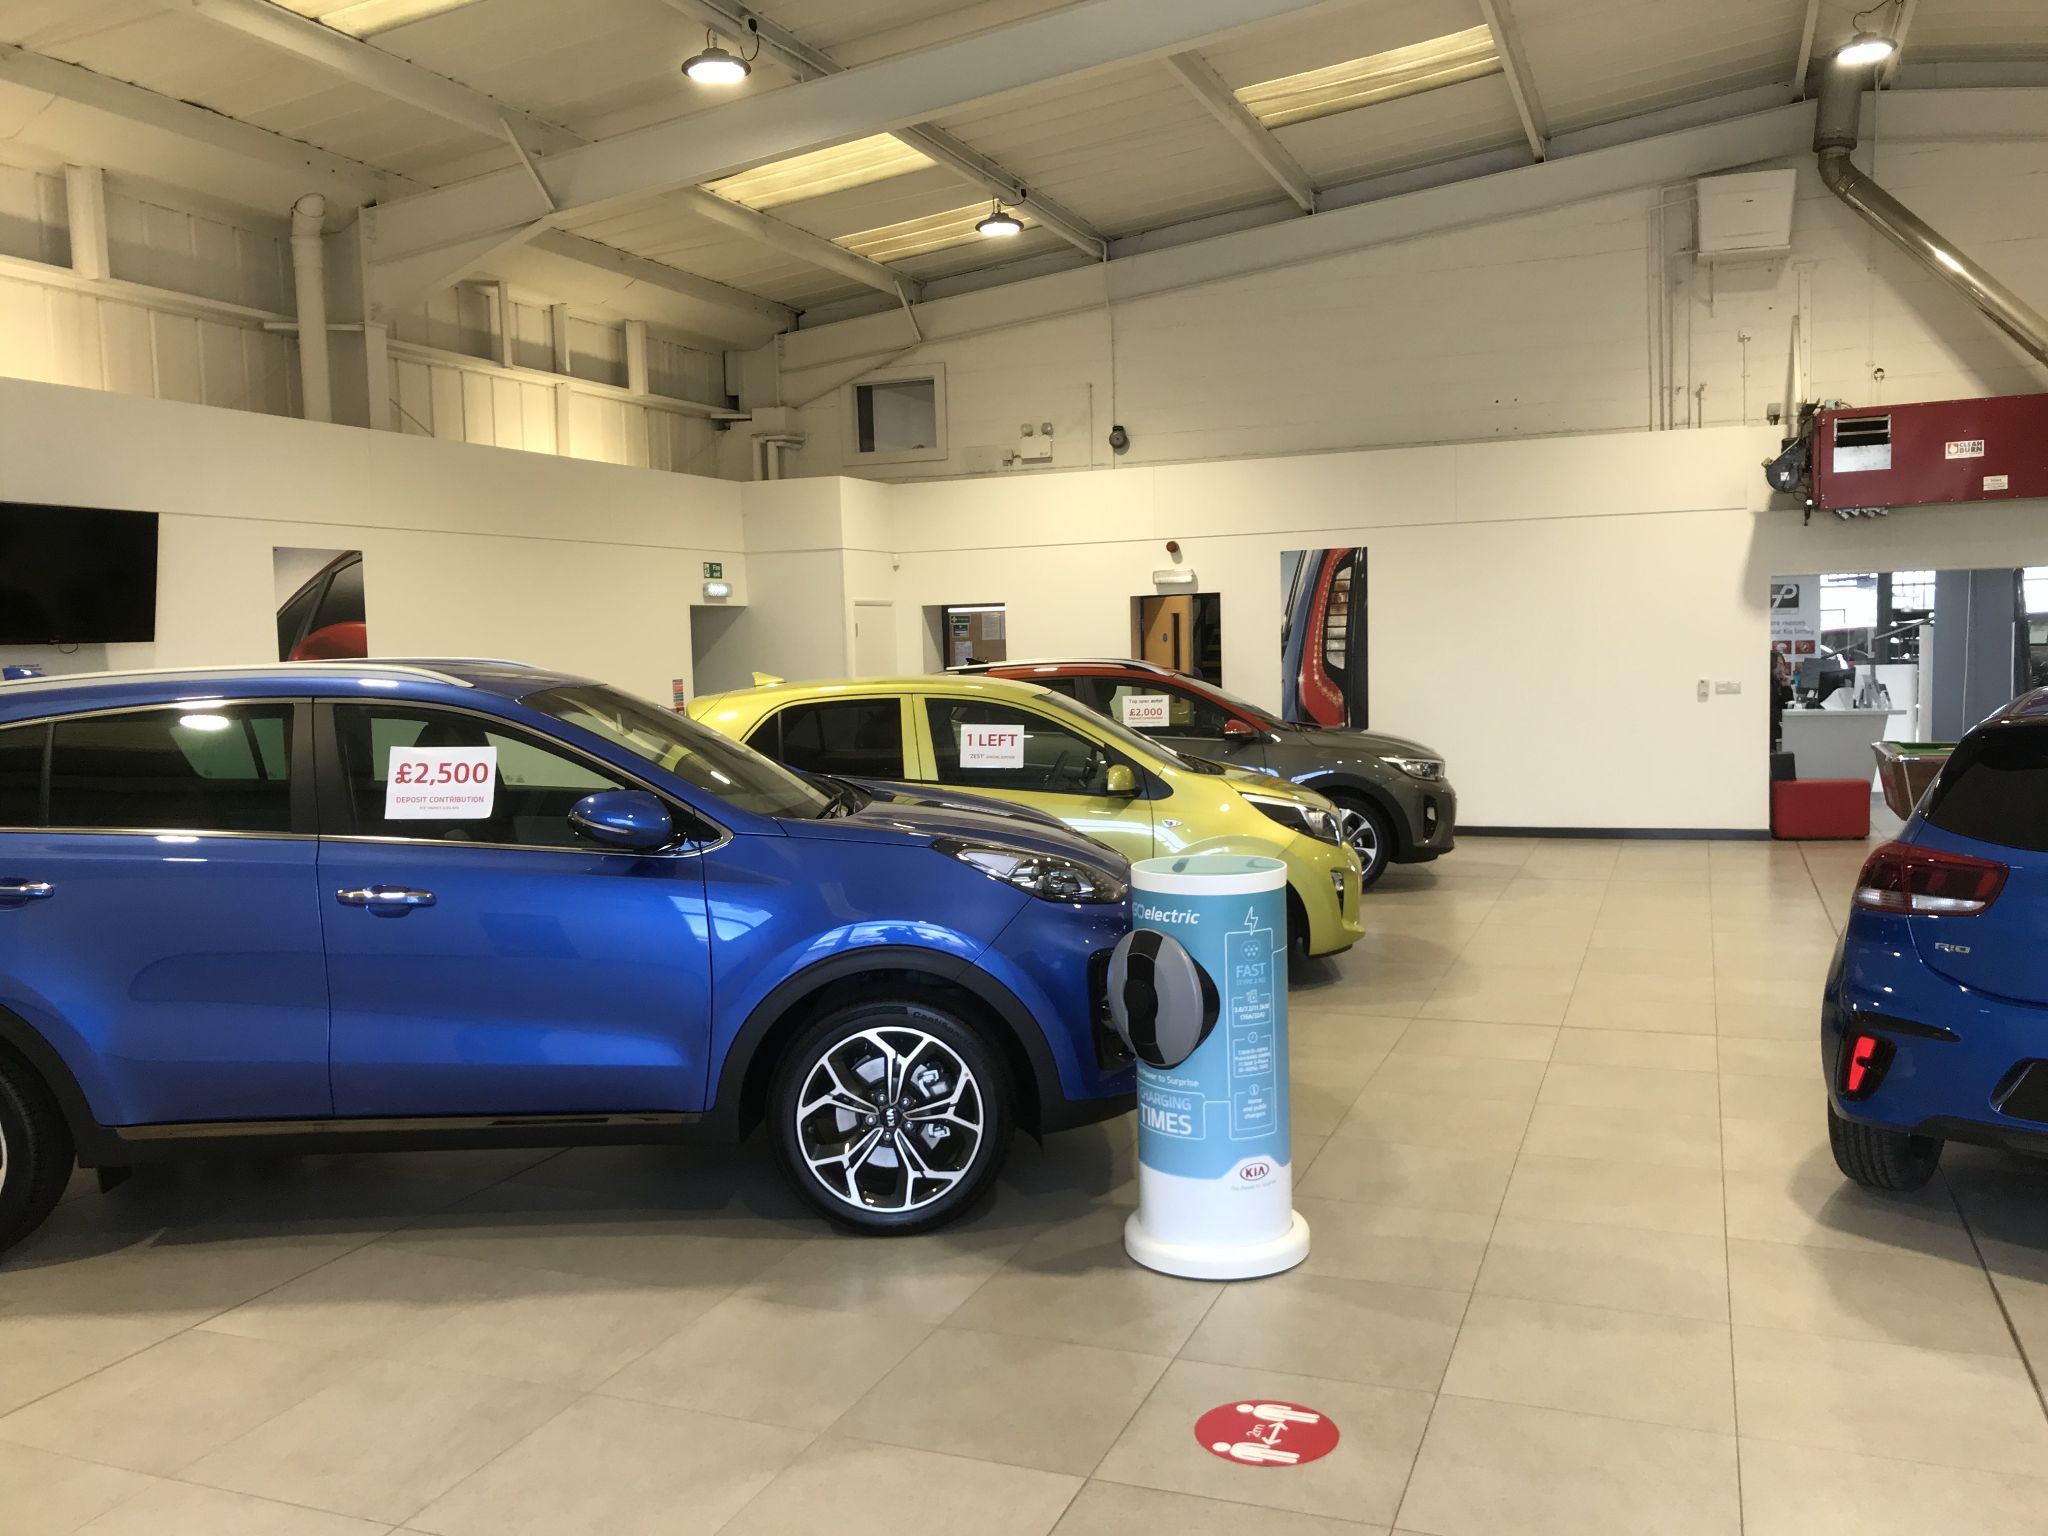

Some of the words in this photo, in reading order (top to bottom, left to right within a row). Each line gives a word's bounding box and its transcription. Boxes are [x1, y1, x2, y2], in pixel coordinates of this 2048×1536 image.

[1959, 446, 1983, 454] BURN
[1129, 707, 1163, 717] £2,000
[967, 733, 973, 747] 1
[979, 733, 1018, 747] LEFT
[394, 762, 489, 786] £2,500
[396, 796, 427, 804] DEPOSIT
[429, 795, 485, 804] CONTRIBUTION
[1935, 942, 1970, 954] RIO
[1236, 962, 1267, 978] FAST
[1166, 1075, 1200, 1087] Surprise
[1140, 1102, 1193, 1135] TIMES
[1245, 1165, 1265, 1178] KIA
[1246, 1424, 1266, 1438] 2m
